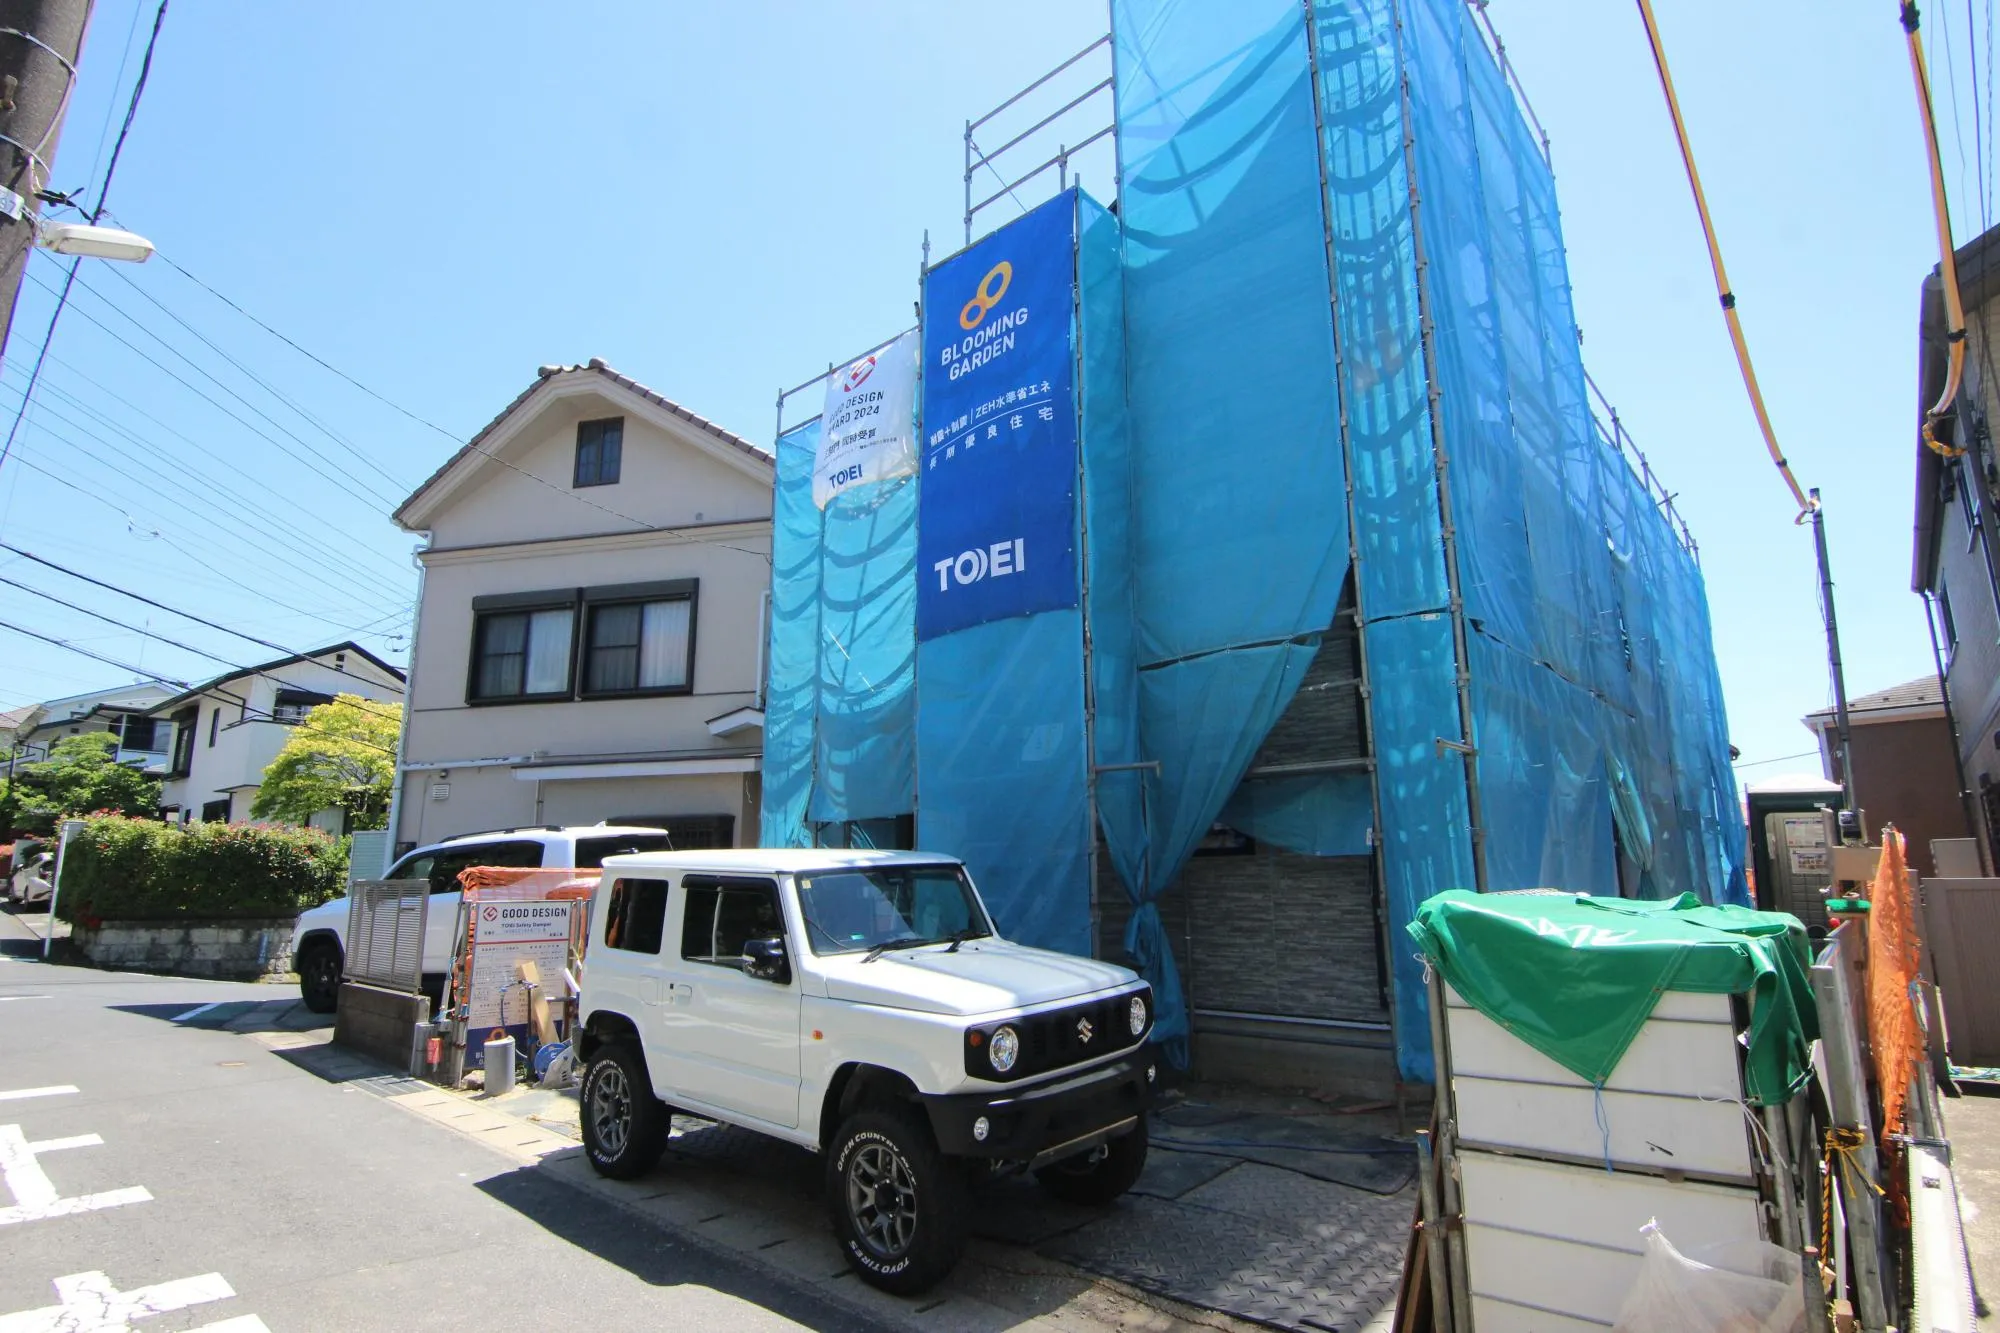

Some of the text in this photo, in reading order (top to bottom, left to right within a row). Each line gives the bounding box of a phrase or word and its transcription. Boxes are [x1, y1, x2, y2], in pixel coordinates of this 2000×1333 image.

[941, 307, 1028, 366] BLOOMING
[949, 332, 1015, 380] GARDEN
[846, 390, 885, 410] DESIGN
[854, 405, 880, 420] 2024
[829, 463, 863, 489] TOEI
[934, 538, 1025, 592] TOEI
[502, 907, 567, 918] GOOD DESIGN
[837, 1139, 855, 1172] OPEN
[855, 1132, 899, 1152] COUNTRY
[849, 1239, 910, 1274] TOYO TIRES
